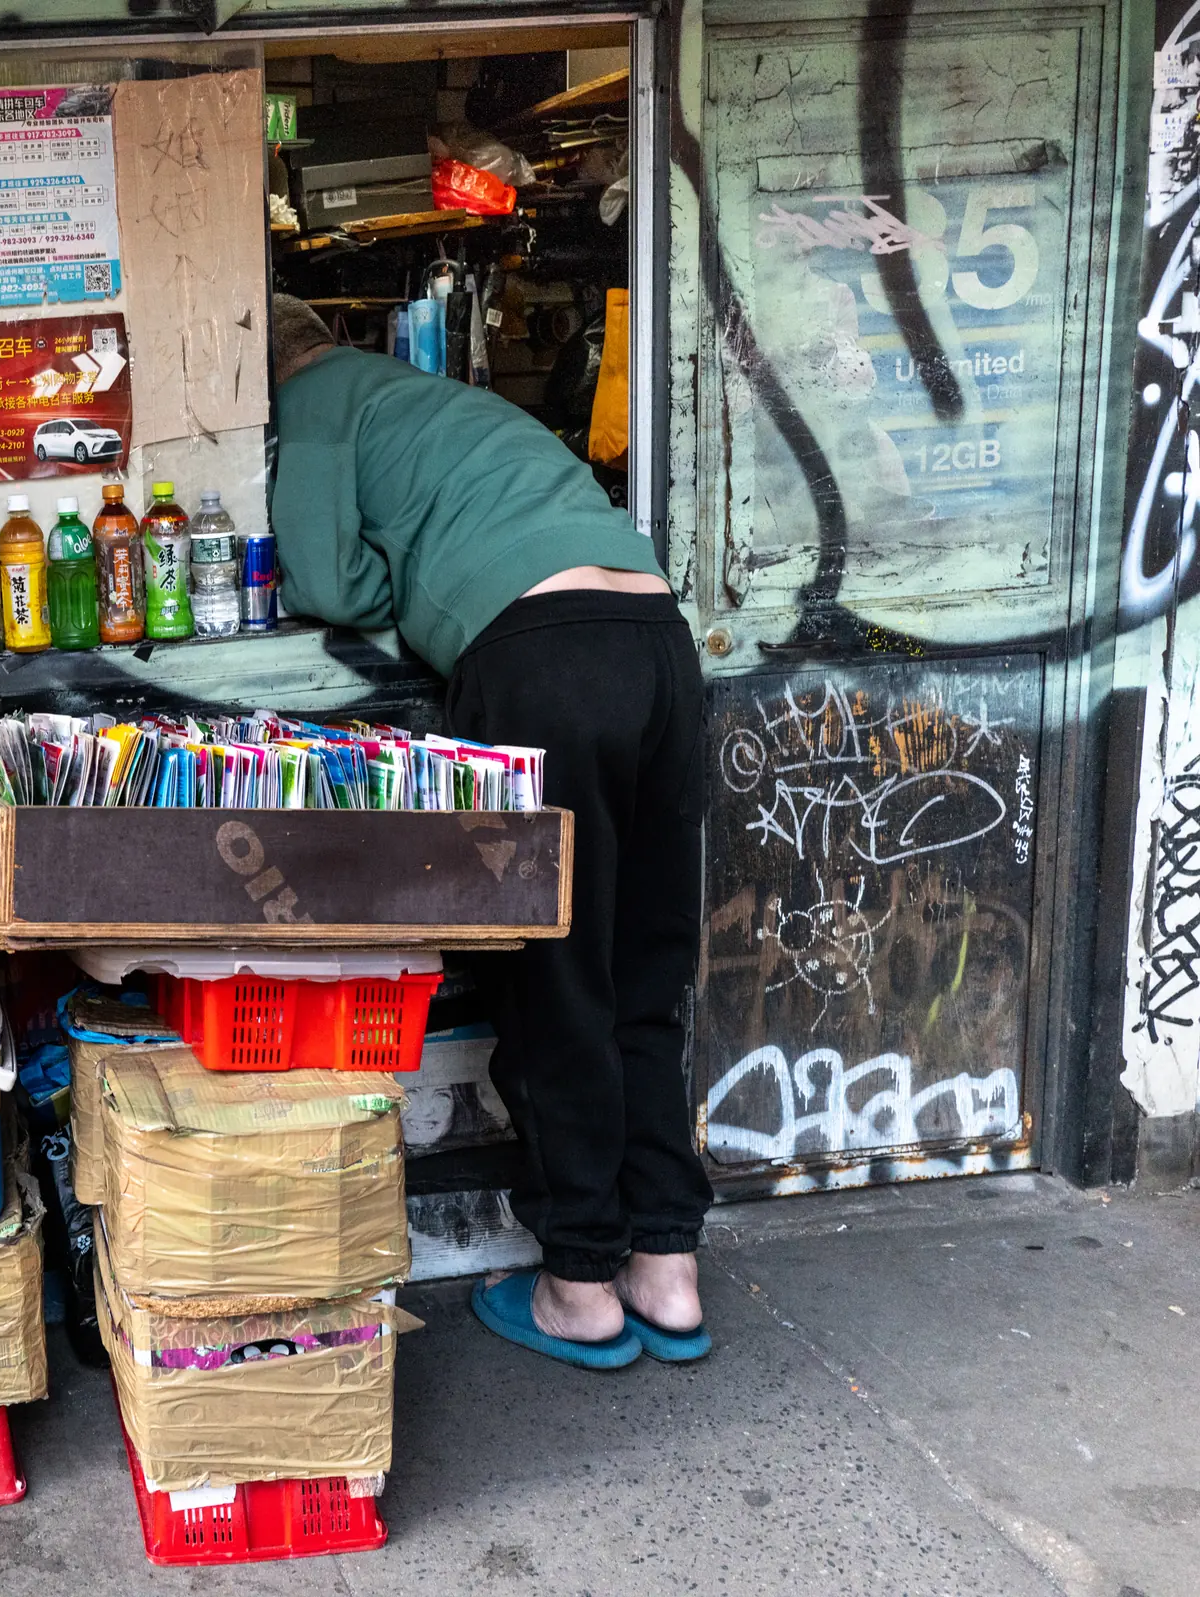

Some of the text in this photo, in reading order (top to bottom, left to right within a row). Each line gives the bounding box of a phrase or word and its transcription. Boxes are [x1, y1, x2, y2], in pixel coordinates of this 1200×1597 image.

[27, 130, 76, 139] 917-982-3093
[30, 176, 81, 186] 929-326-6340
[45, 233, 95, 242] 929-326-6340
[914, 439, 1001, 473] 12GB
[74, 533, 92, 554] aloe
[159, 544, 177, 592] 绿茶
[252, 570, 273, 581] Red
[11, 576, 30, 624] 菊花茶
